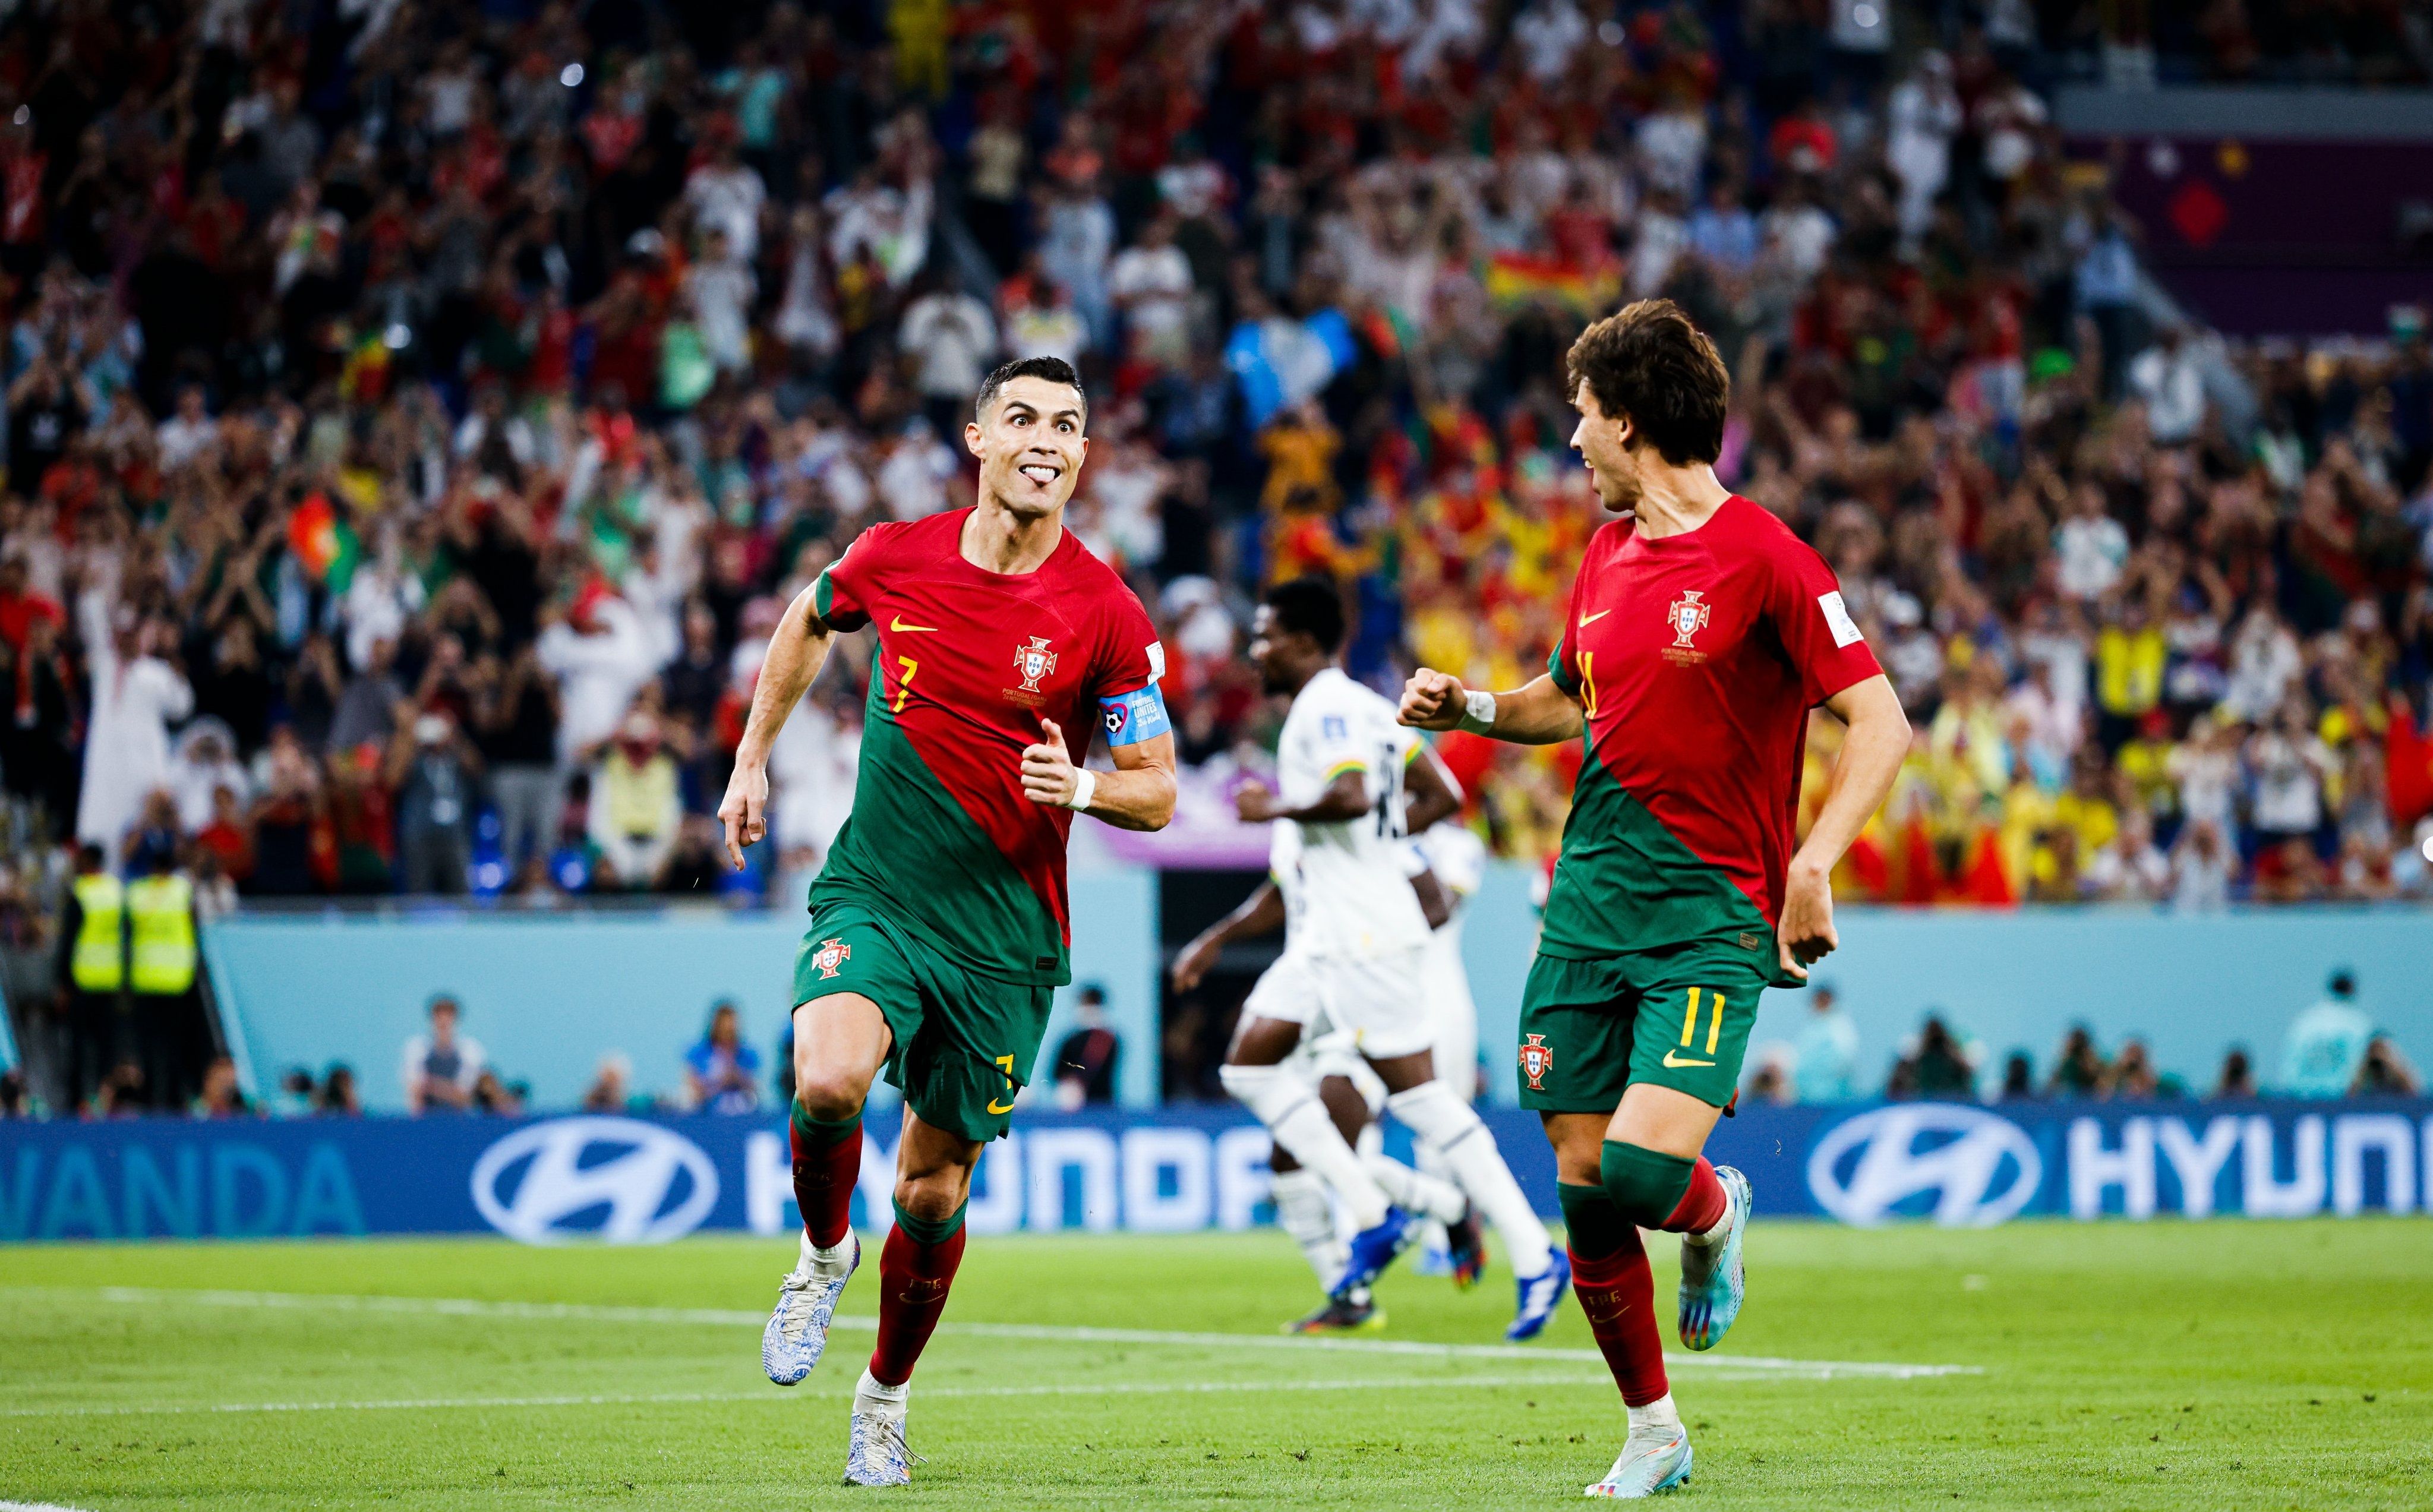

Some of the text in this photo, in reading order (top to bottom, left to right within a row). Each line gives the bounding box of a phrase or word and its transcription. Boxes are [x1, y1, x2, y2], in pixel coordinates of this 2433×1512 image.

[892, 655, 918, 713] 7
[1132, 694, 1155, 709] FOOTBALL
[1134, 701, 1157, 719] UNITES
[1576, 651, 1597, 719] 11
[1680, 987, 1725, 1055] 11
[996, 1054, 1014, 1090] 7
[2068, 1115, 2433, 1220] HYUN
